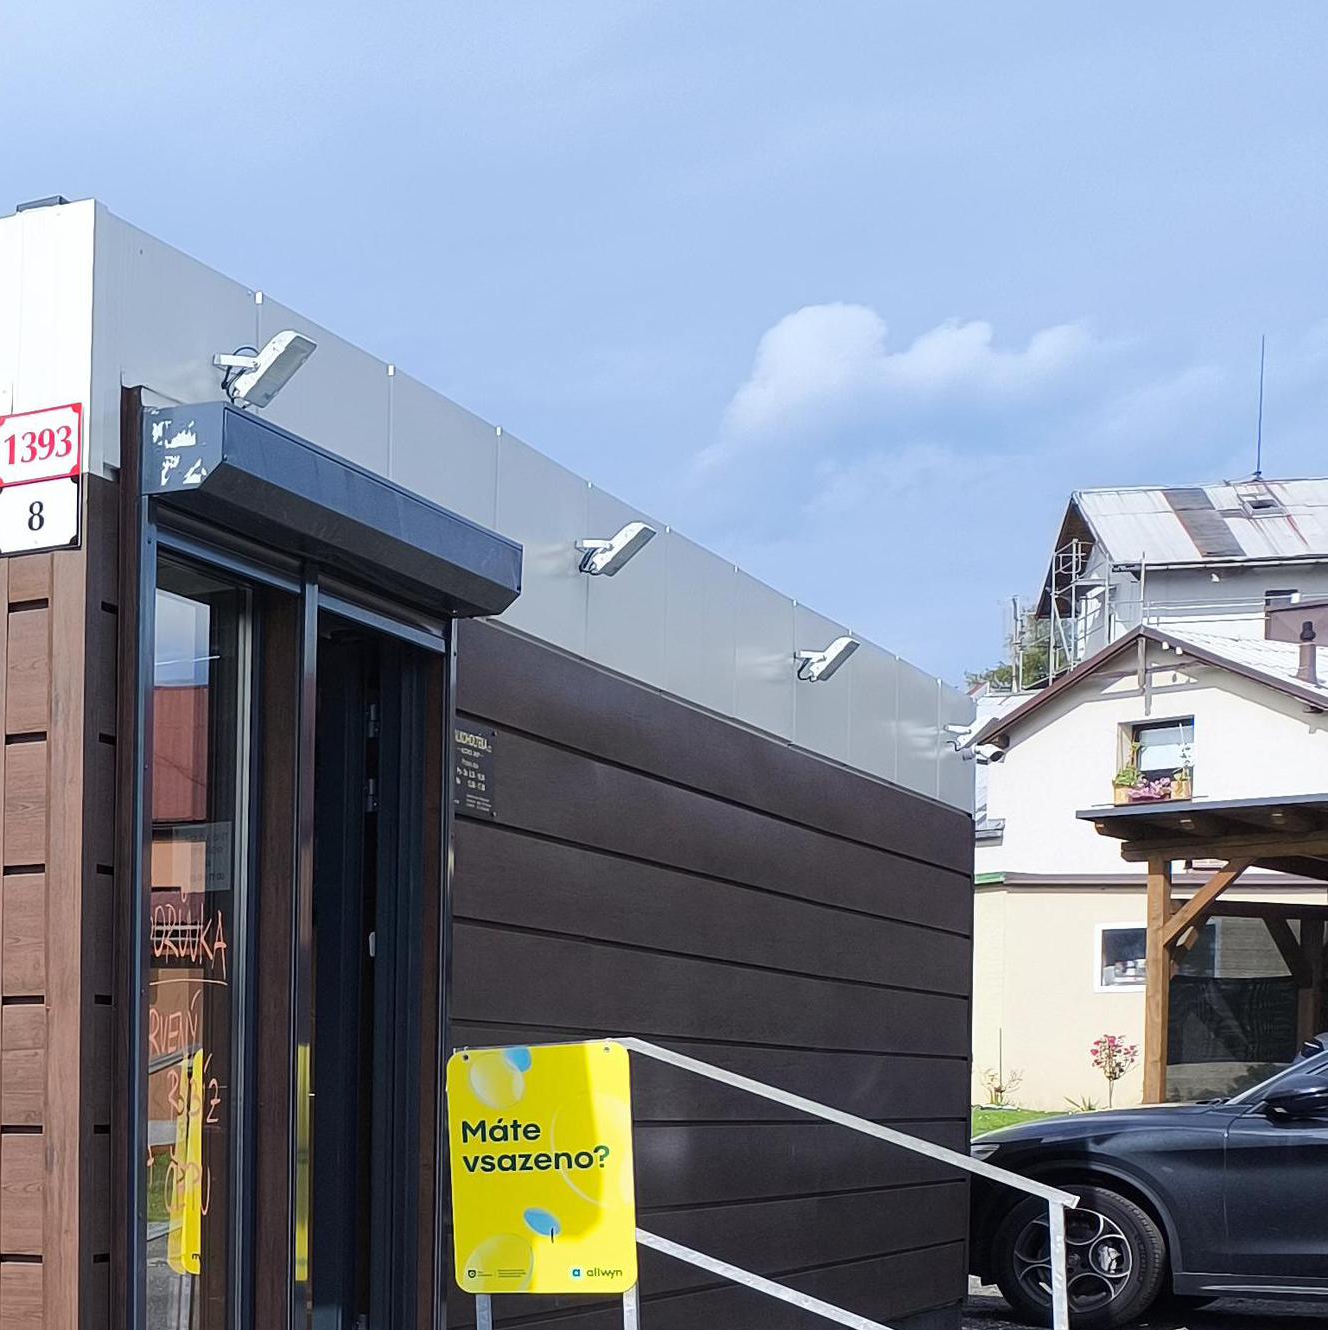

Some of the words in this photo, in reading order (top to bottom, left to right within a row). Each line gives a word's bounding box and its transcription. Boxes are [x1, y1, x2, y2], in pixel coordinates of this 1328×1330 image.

[3, 425, 73, 465] 1393
[27, 500, 46, 532] 8
[461, 1117, 542, 1144] Máte
[462, 1144, 611, 1173] vsazeno?
